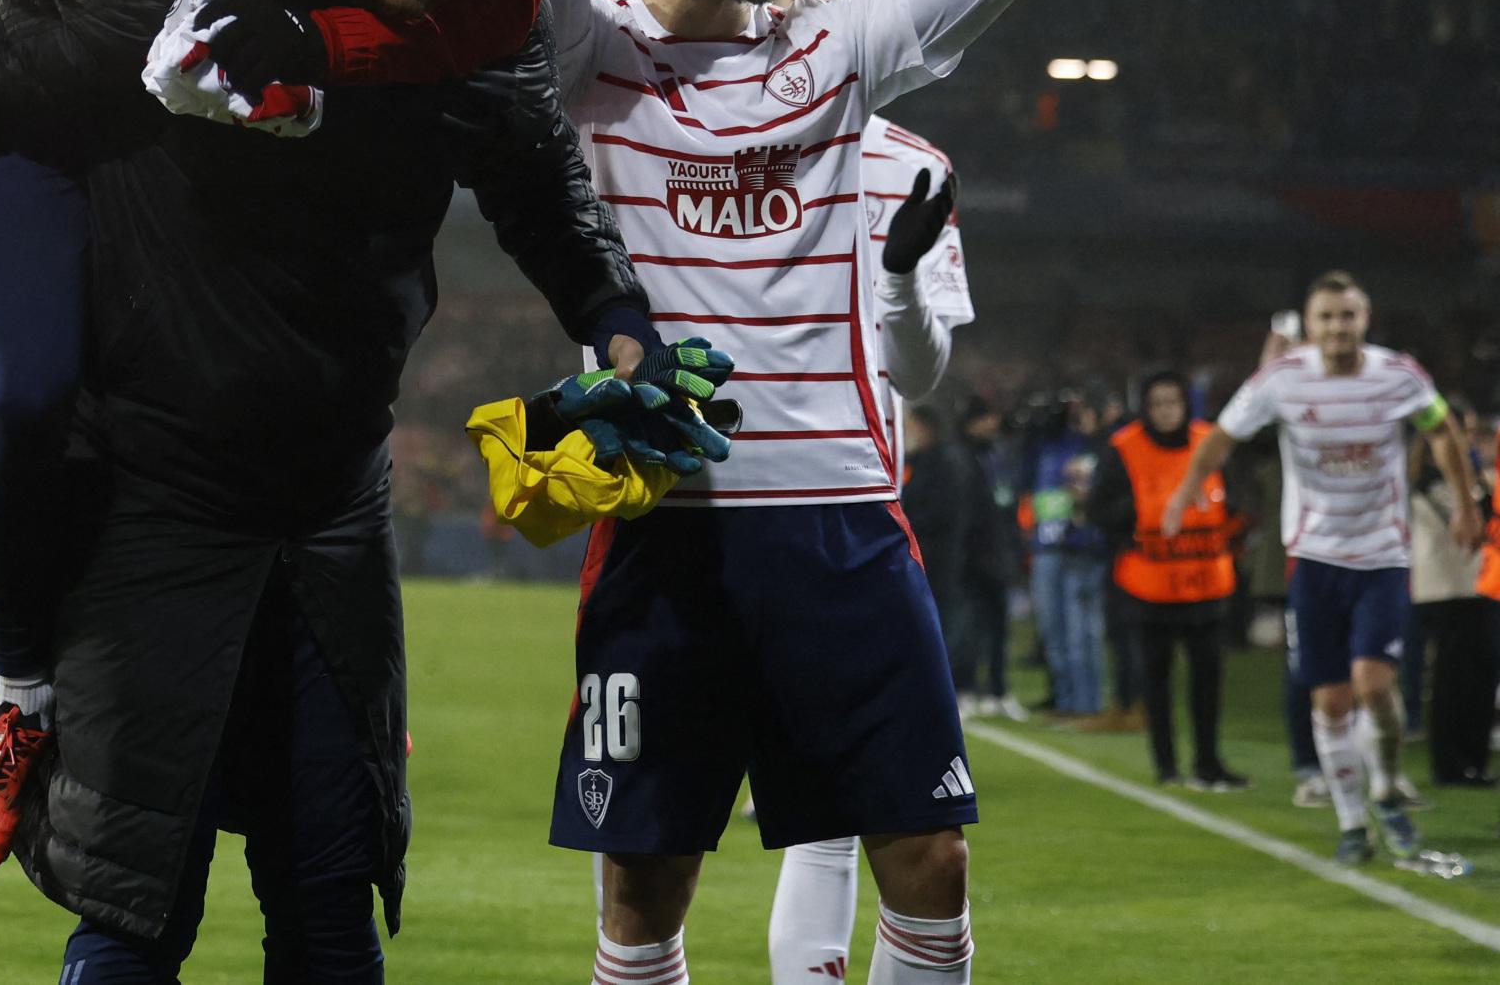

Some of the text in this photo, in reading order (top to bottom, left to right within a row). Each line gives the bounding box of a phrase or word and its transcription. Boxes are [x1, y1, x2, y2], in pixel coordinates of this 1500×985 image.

[668, 161, 731, 179] YAOURT
[677, 188, 798, 236] MALO
[580, 672, 641, 761] 26
[584, 790, 604, 805] SB
